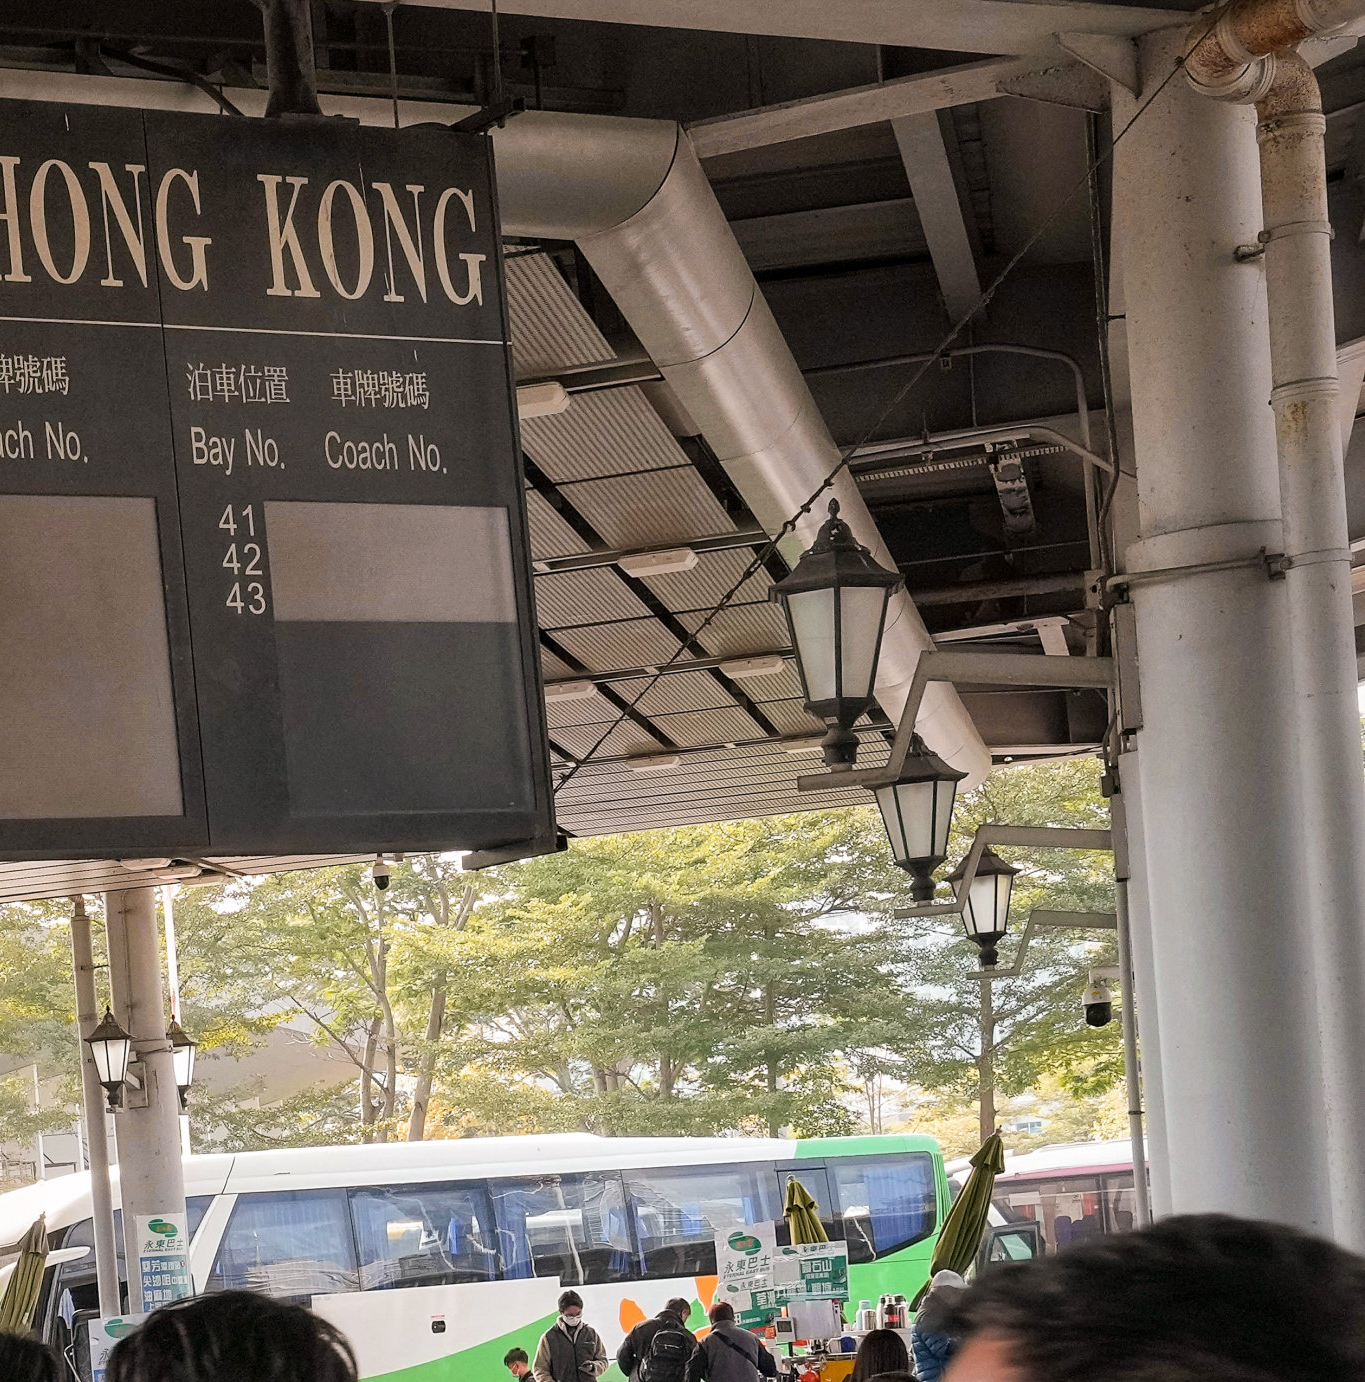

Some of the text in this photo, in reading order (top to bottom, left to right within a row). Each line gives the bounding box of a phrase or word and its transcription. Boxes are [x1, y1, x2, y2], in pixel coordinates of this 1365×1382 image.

[256, 173, 486, 307] KONG
[187, 363, 289, 403] 泊車位置
[334, 369, 429, 409] 車牌號碼
[46, 422, 87, 462] No.
[191, 427, 284, 475] Bay No.
[325, 432, 446, 473] Coach No.
[219, 505, 254, 536] 41
[223, 544, 262, 574] 42
[227, 583, 265, 614] 43
[723, 1255, 771, 1274] 永東巴士
